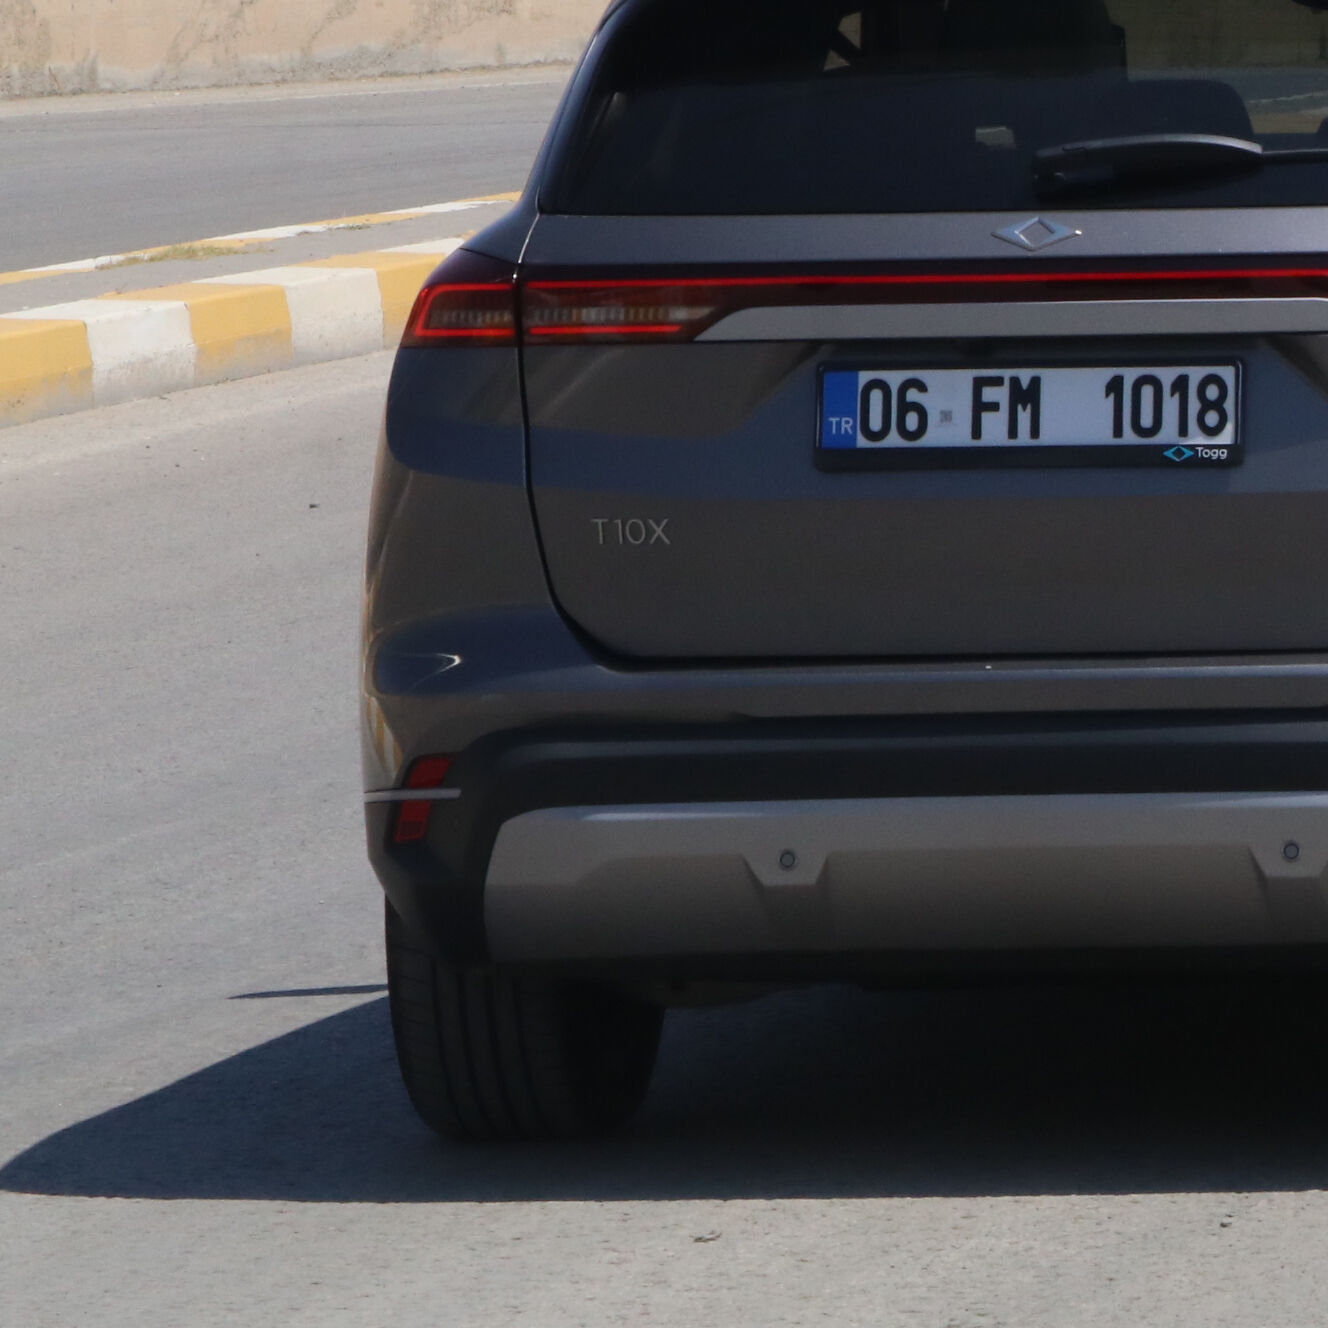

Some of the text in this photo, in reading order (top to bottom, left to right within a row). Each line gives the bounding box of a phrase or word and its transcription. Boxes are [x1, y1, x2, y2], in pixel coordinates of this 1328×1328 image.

[860, 373, 1229, 442] 06 FM 1018
[828, 416, 854, 435] TR
[1195, 446, 1228, 460] Togg
[590, 517, 671, 545] T10X
